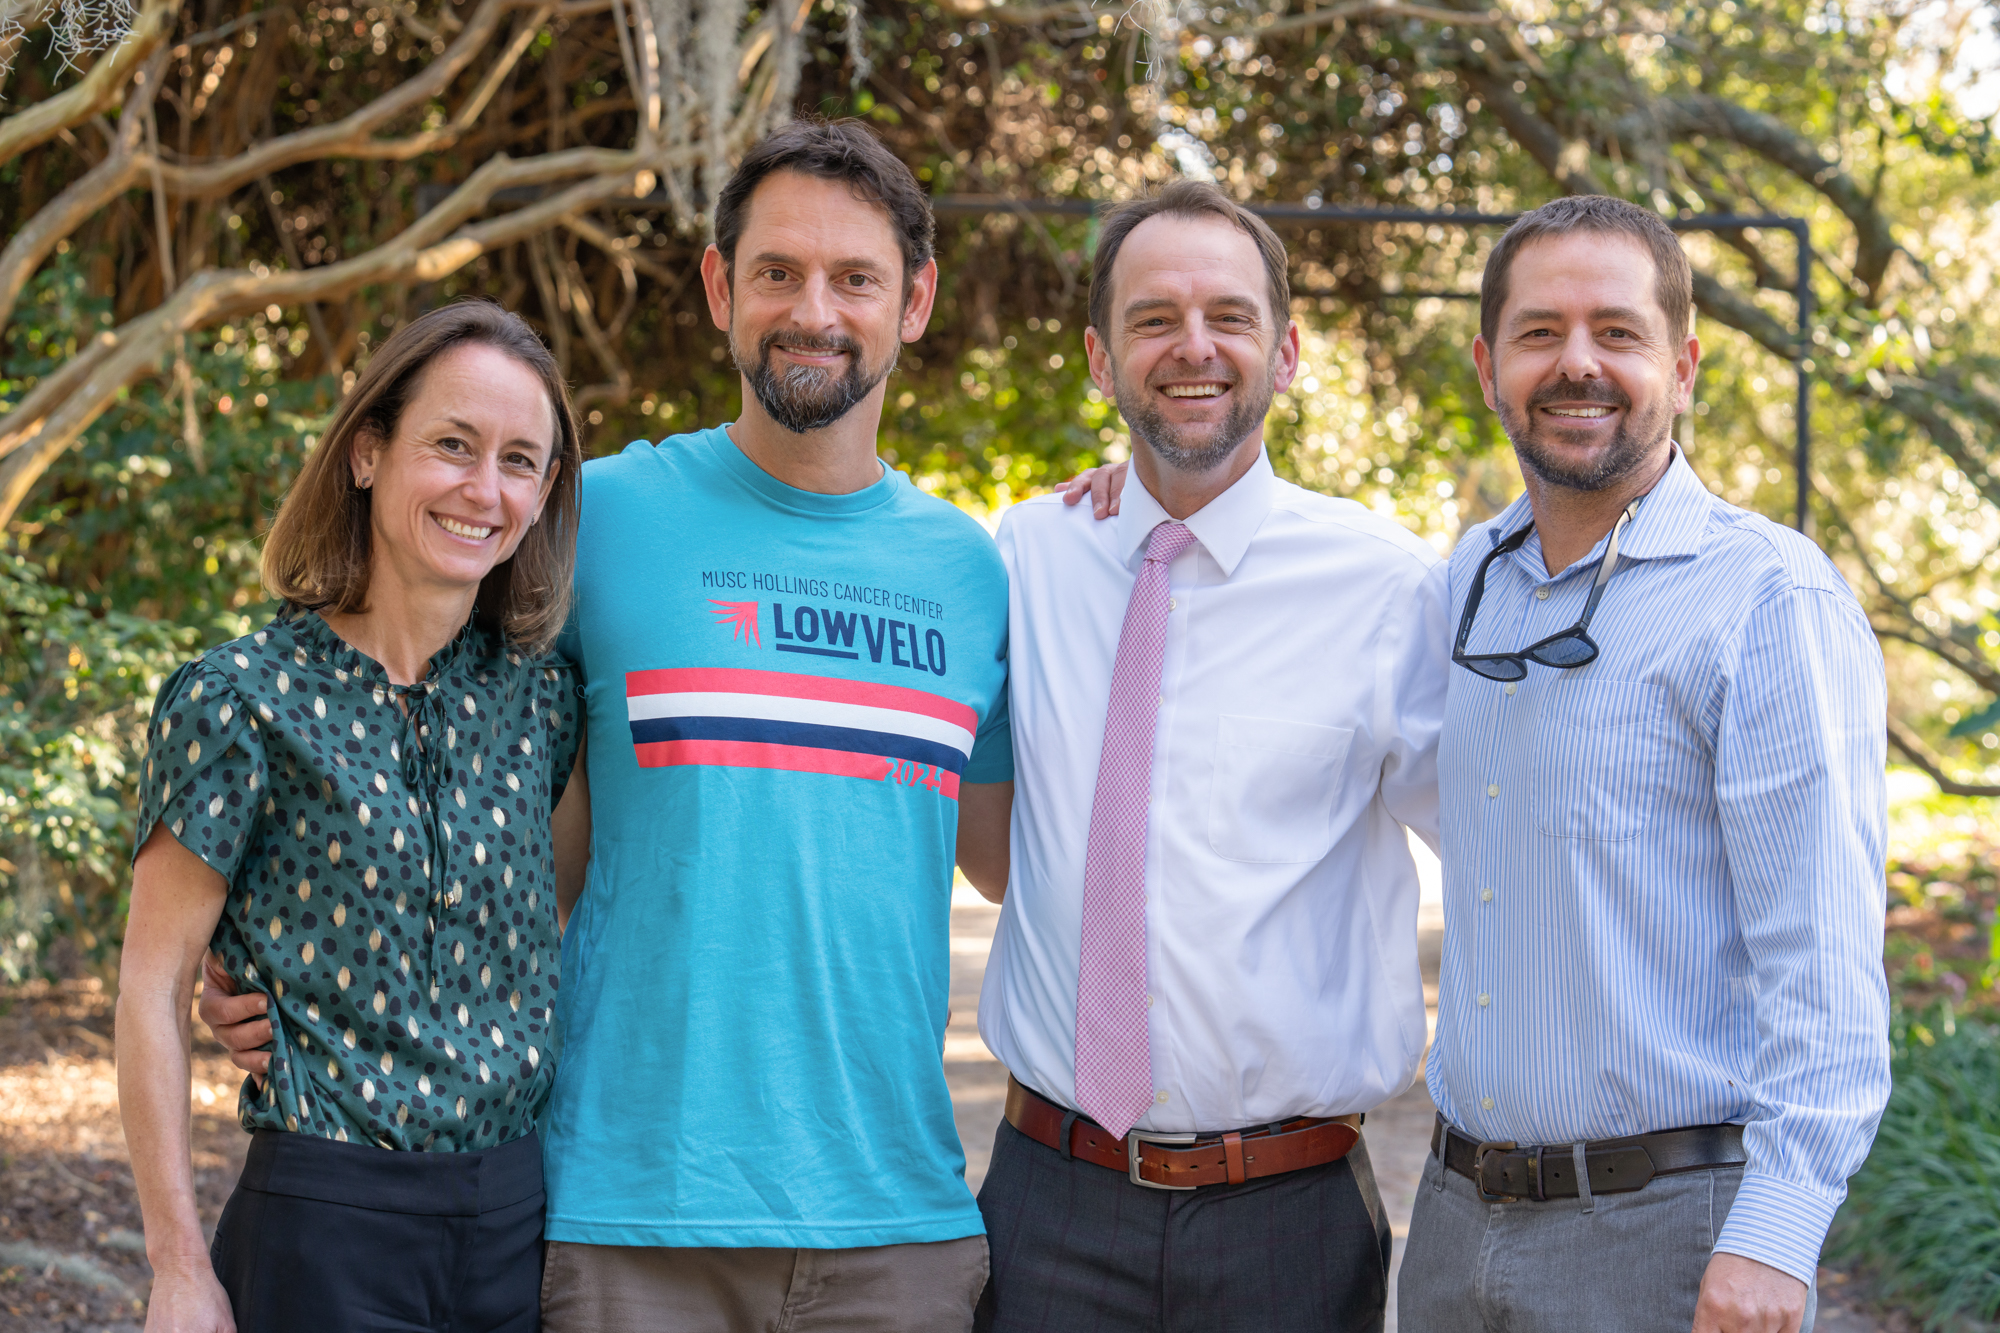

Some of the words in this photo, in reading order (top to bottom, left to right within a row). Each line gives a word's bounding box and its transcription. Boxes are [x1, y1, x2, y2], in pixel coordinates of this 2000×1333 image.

[702, 571, 747, 588] MUSC
[754, 573, 829, 598] HOLLINGS
[834, 583, 890, 607] CANCER
[894, 593, 943, 621] CENTER
